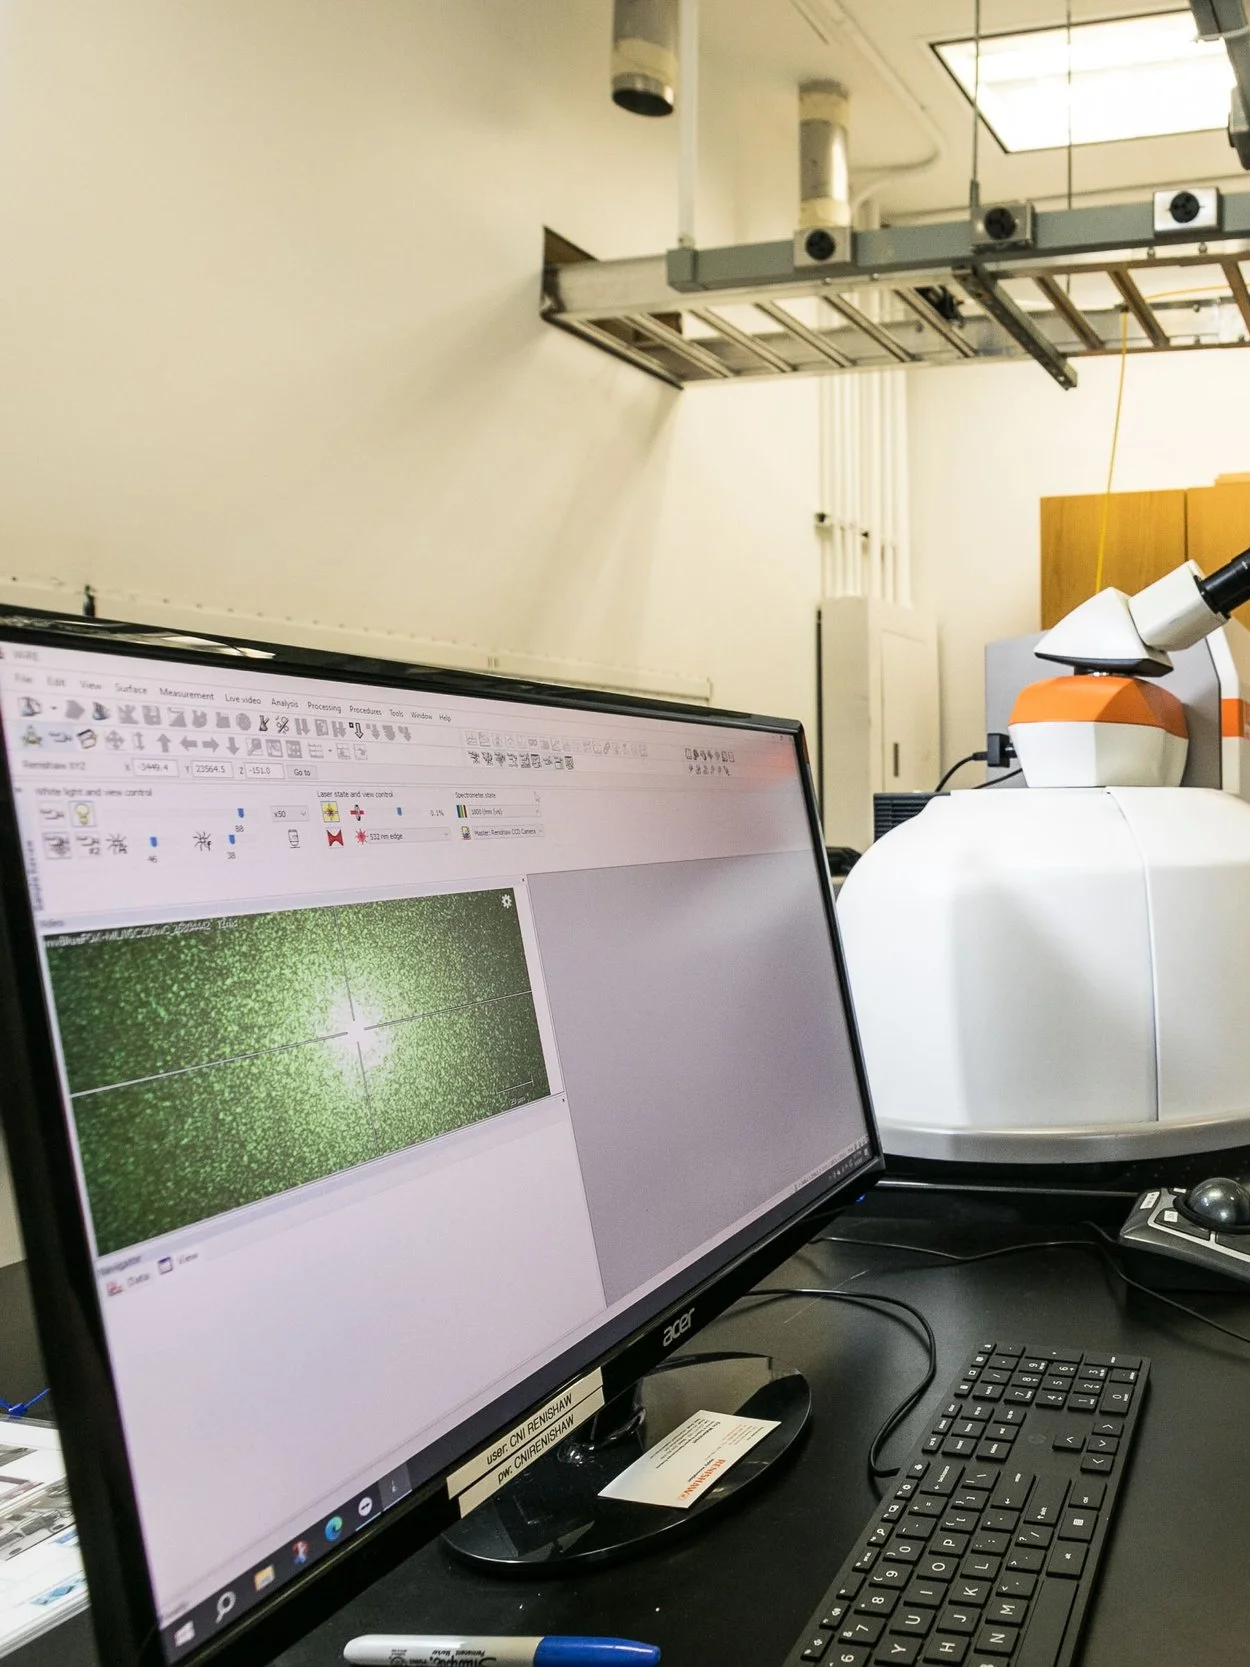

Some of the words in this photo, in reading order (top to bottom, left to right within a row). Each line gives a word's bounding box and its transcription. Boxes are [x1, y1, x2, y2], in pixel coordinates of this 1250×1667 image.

[46, 676, 66, 687] Edit
[114, 683, 148, 694] Surface
[159, 687, 215, 701] Measurement
[225, 694, 240, 703] Live
[241, 696, 262, 705] video
[271, 698, 299, 709] Analysis
[307, 701, 342, 713] Processing
[349, 705, 382, 716] Procedures
[389, 709, 404, 718] Tools
[411, 711, 433, 720] Window
[439, 714, 452, 722] Help
[293, 768, 303, 777] Go
[303, 769, 311, 777] to
[316, 790, 333, 798] Laser
[390, 833, 403, 841] edge
[663, 1307, 695, 1347] acer
[486, 1443, 508, 1465] user:
[509, 1428, 526, 1448] CNI
[527, 1393, 573, 1435] RENISHAW
[497, 1466, 513, 1485] pw:
[514, 1414, 574, 1469] CNIRENISHAW
[942, 1539, 956, 1547] P
[899, 1545, 911, 1553] 0
[931, 1562, 946, 1572] O
[885, 1570, 898, 1578] 9
[963, 1587, 979, 1596] K
[871, 1596, 885, 1605] 8
[999, 1604, 1016, 1615] M
[905, 1615, 921, 1625] U
[953, 1614, 967, 1623] J
[855, 1624, 869, 1632] 7
[989, 1633, 1006, 1644] N
[890, 1643, 907, 1654] Y
[939, 1642, 956, 1653] H
[840, 1654, 855, 1663] 6
